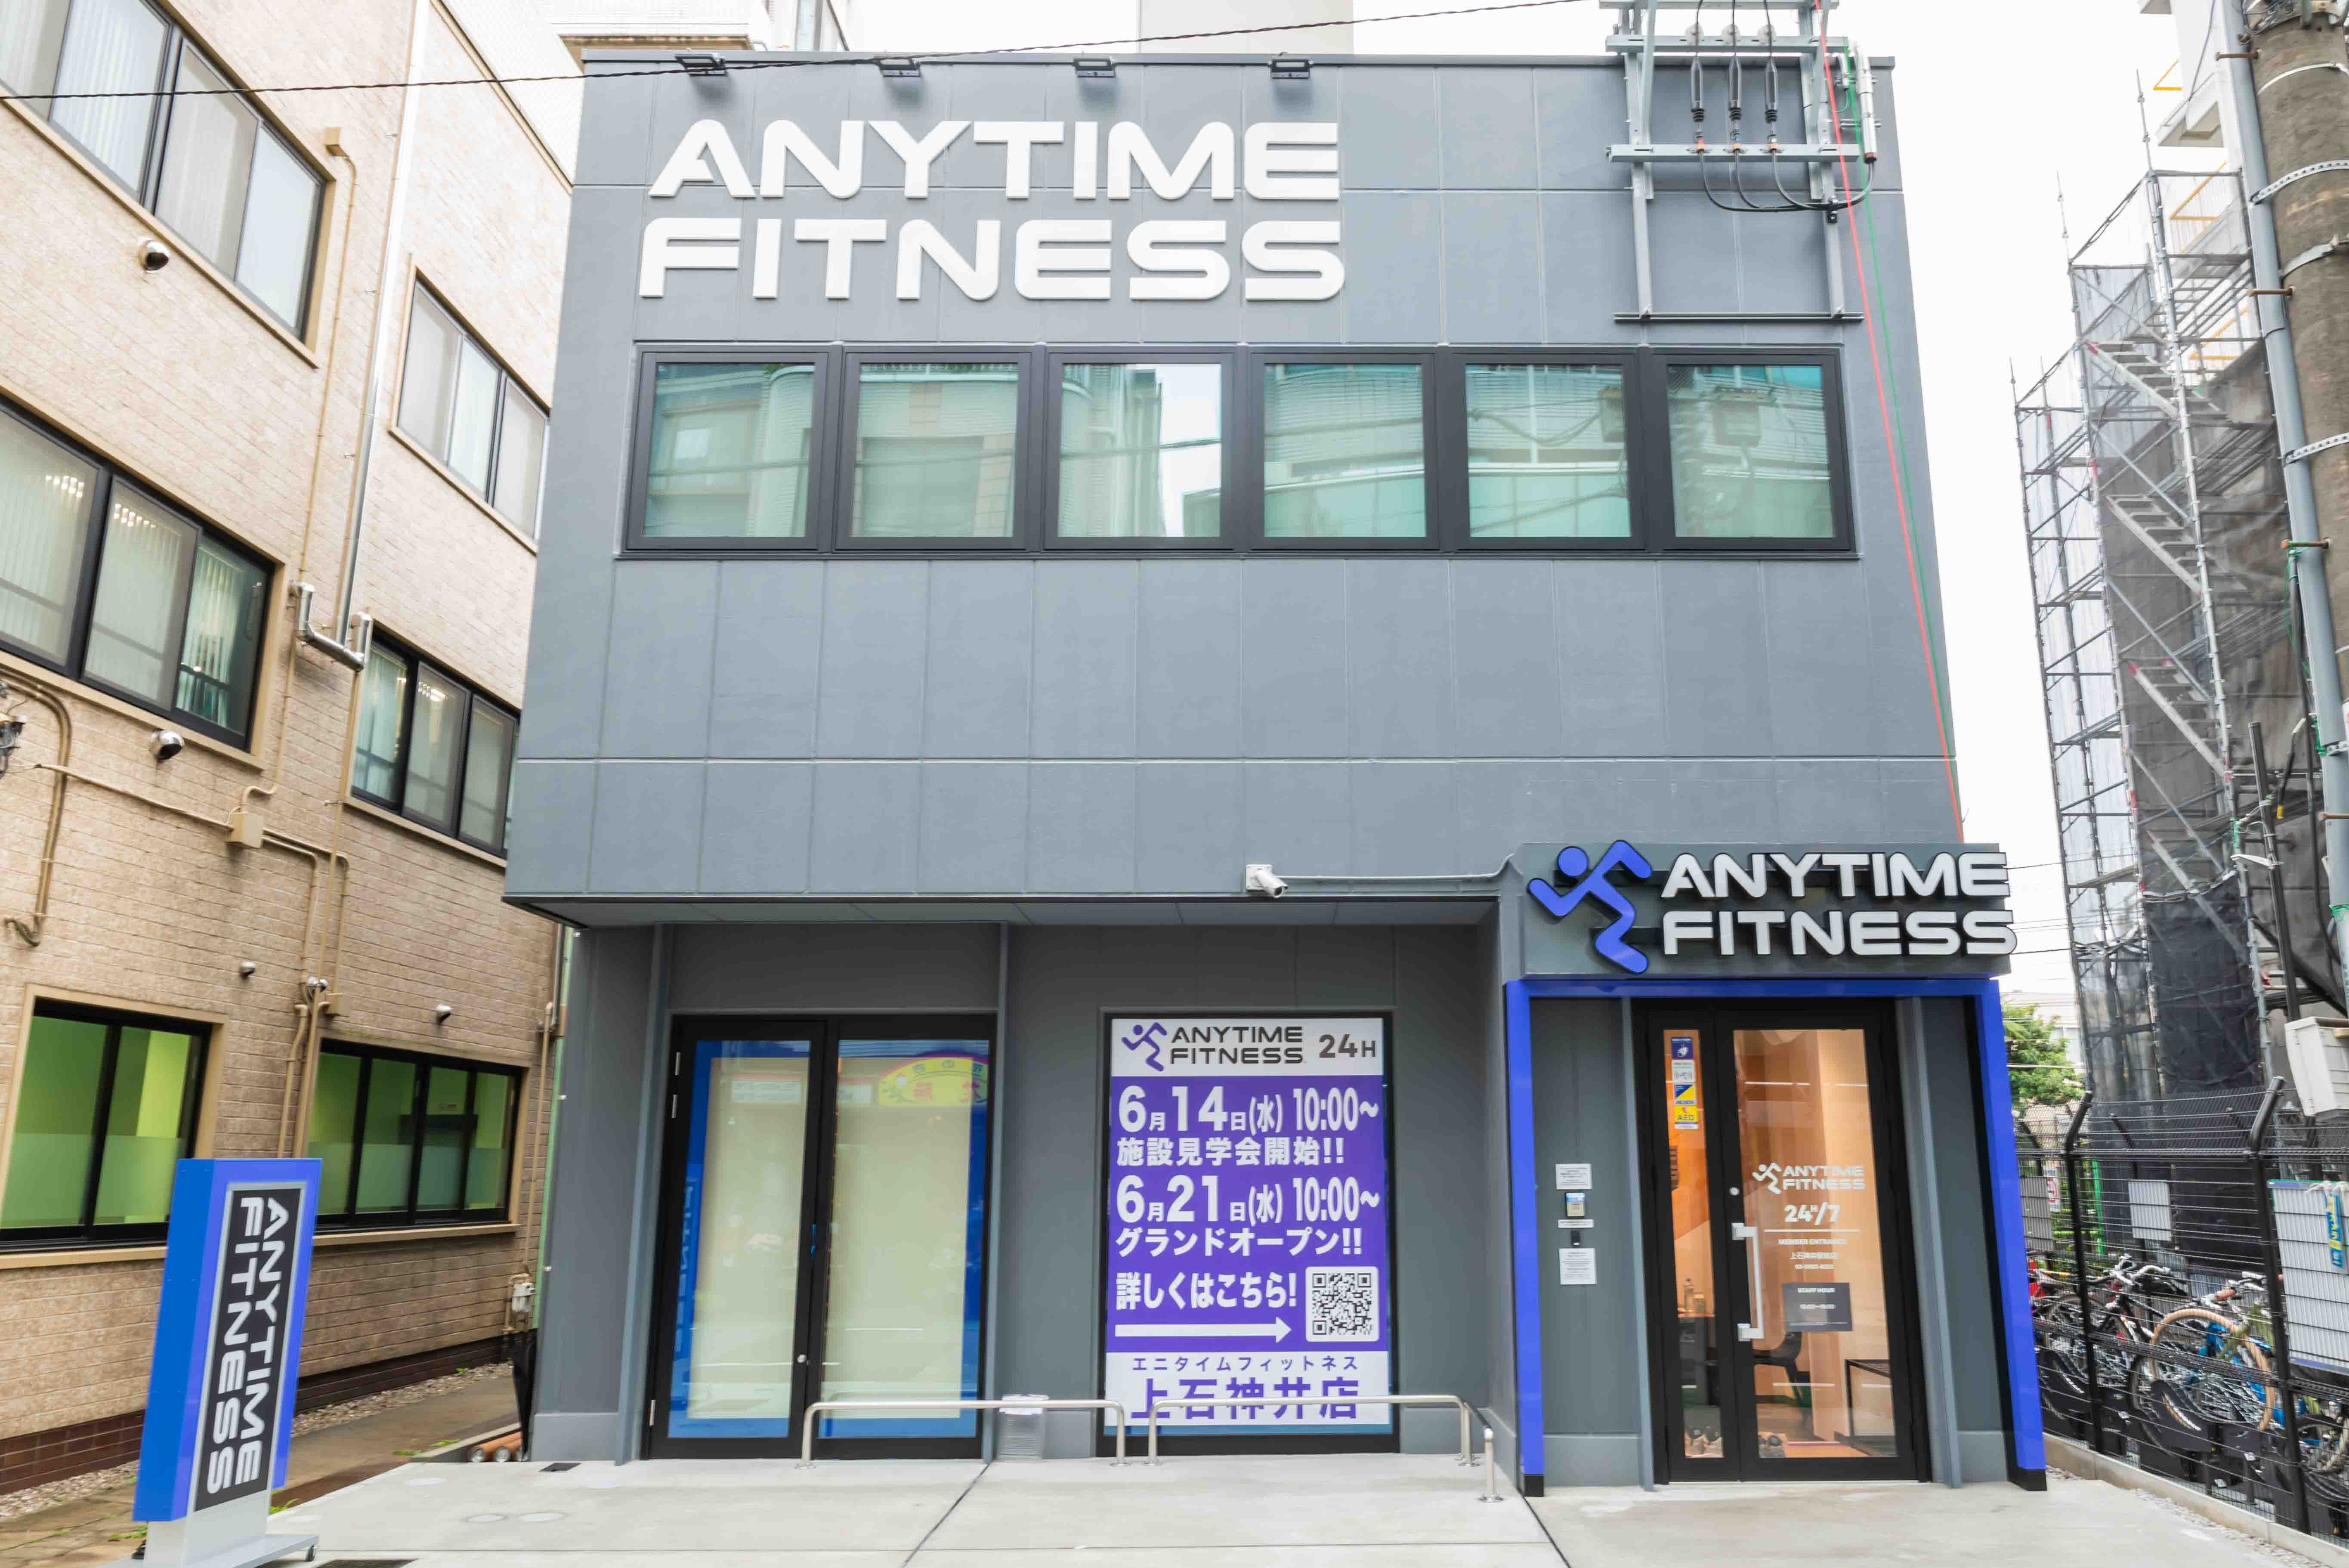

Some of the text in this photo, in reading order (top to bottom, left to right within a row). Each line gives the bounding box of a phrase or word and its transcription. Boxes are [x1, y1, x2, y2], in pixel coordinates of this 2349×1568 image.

[648, 119, 1341, 200] ANYTIME
[639, 217, 1346, 301] FITNESS
[1661, 851, 2011, 898] ANYTIME
[1662, 909, 2018, 956] FITNESS
[1171, 1026, 1303, 1043] ANYTIME
[1318, 1034, 1376, 1058] 24H
[1170, 1047, 1304, 1064] FITNESS
[1116, 1136, 1344, 1167] 施設見学会開始!!
[1783, 1165, 1866, 1177] ANYTIME
[1783, 1178, 1866, 1190] FITNESS
[1115, 1227, 1362, 1258] グランドオープン!!
[1116, 1272, 1297, 1310] 詳しくはこちら!
[207, 1197, 265, 1495] FITNESS
[235, 1197, 289, 1485] ANYTIME
[1132, 1355, 1358, 1372] エニタイムフィットネス
[1131, 1376, 1359, 1420] 上石神井店
